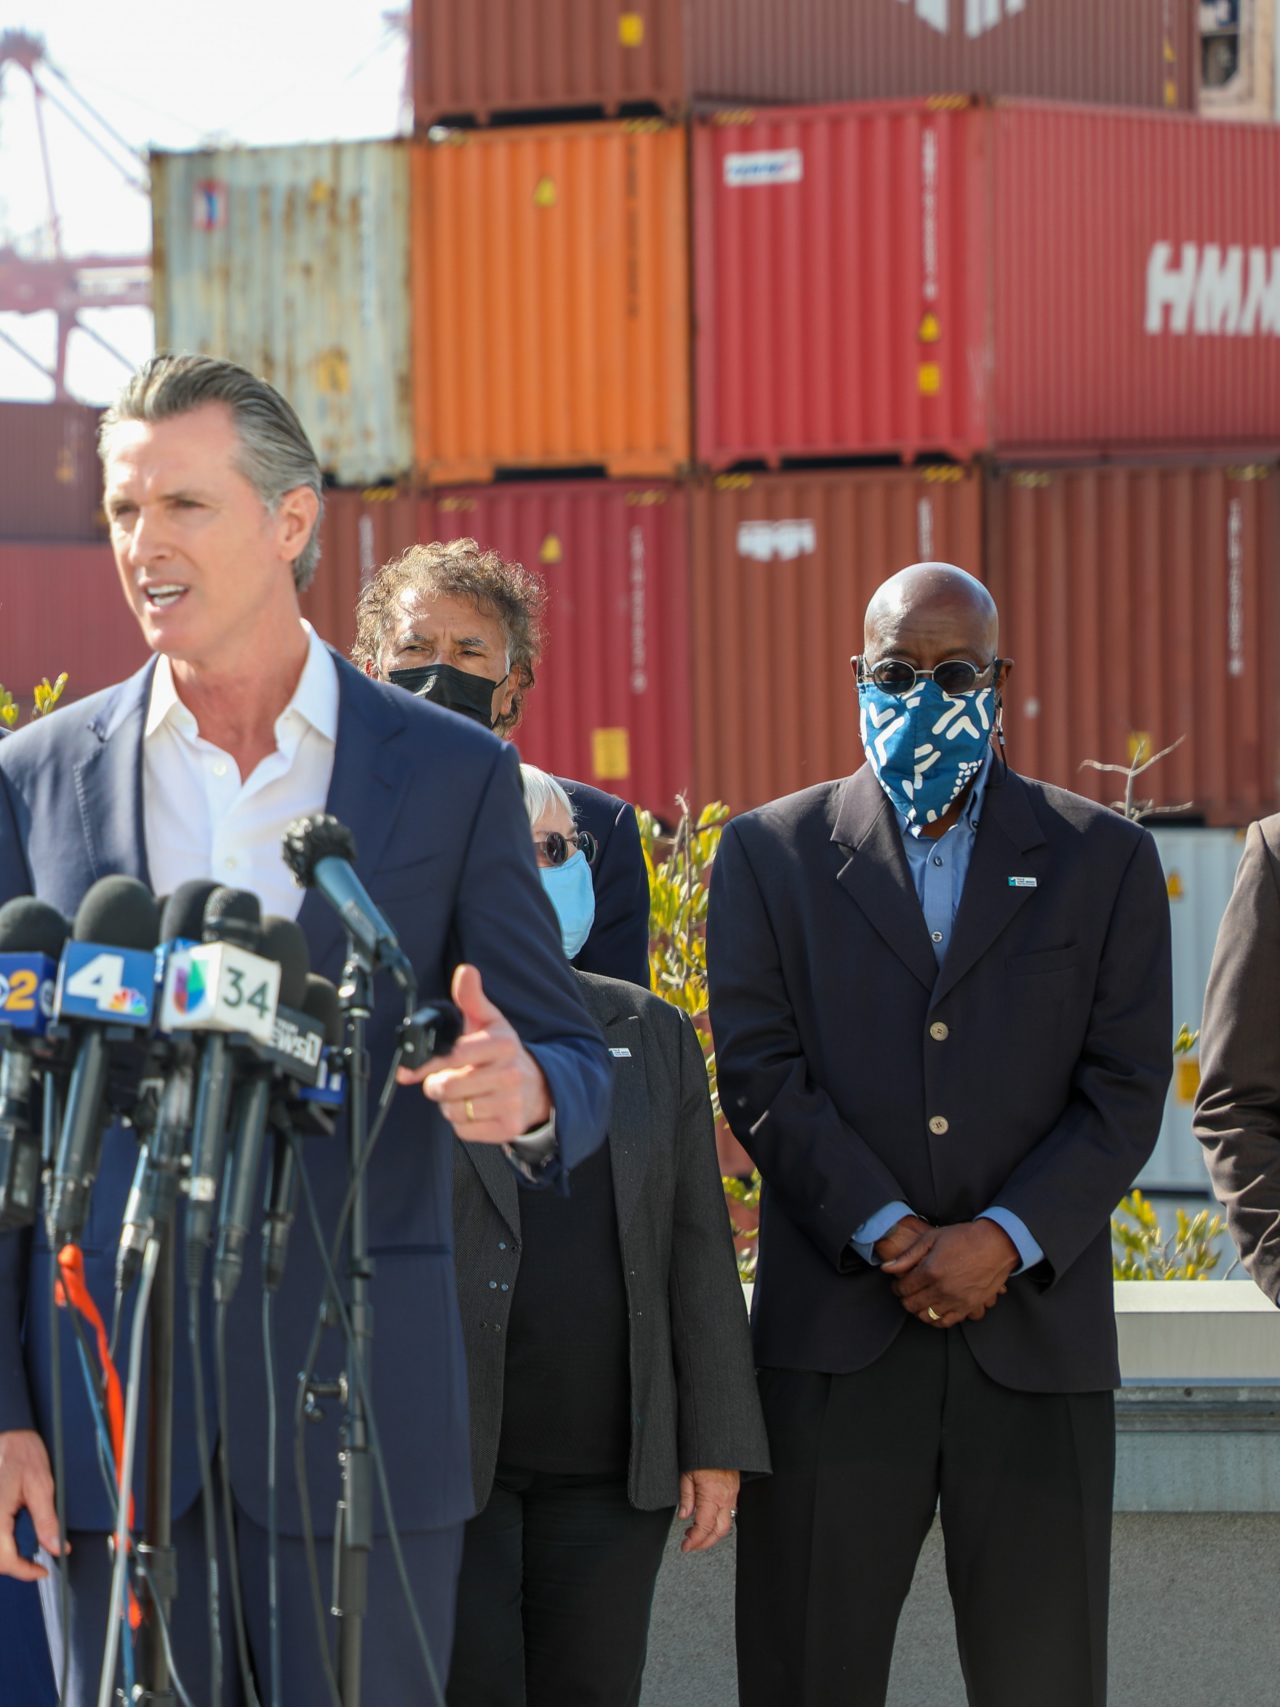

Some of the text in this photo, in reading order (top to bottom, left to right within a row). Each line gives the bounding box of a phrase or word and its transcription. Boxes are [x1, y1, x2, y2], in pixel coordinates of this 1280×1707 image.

[4, 970, 38, 1011] 2
[66, 952, 126, 1012] 4
[223, 966, 270, 1020] 34
